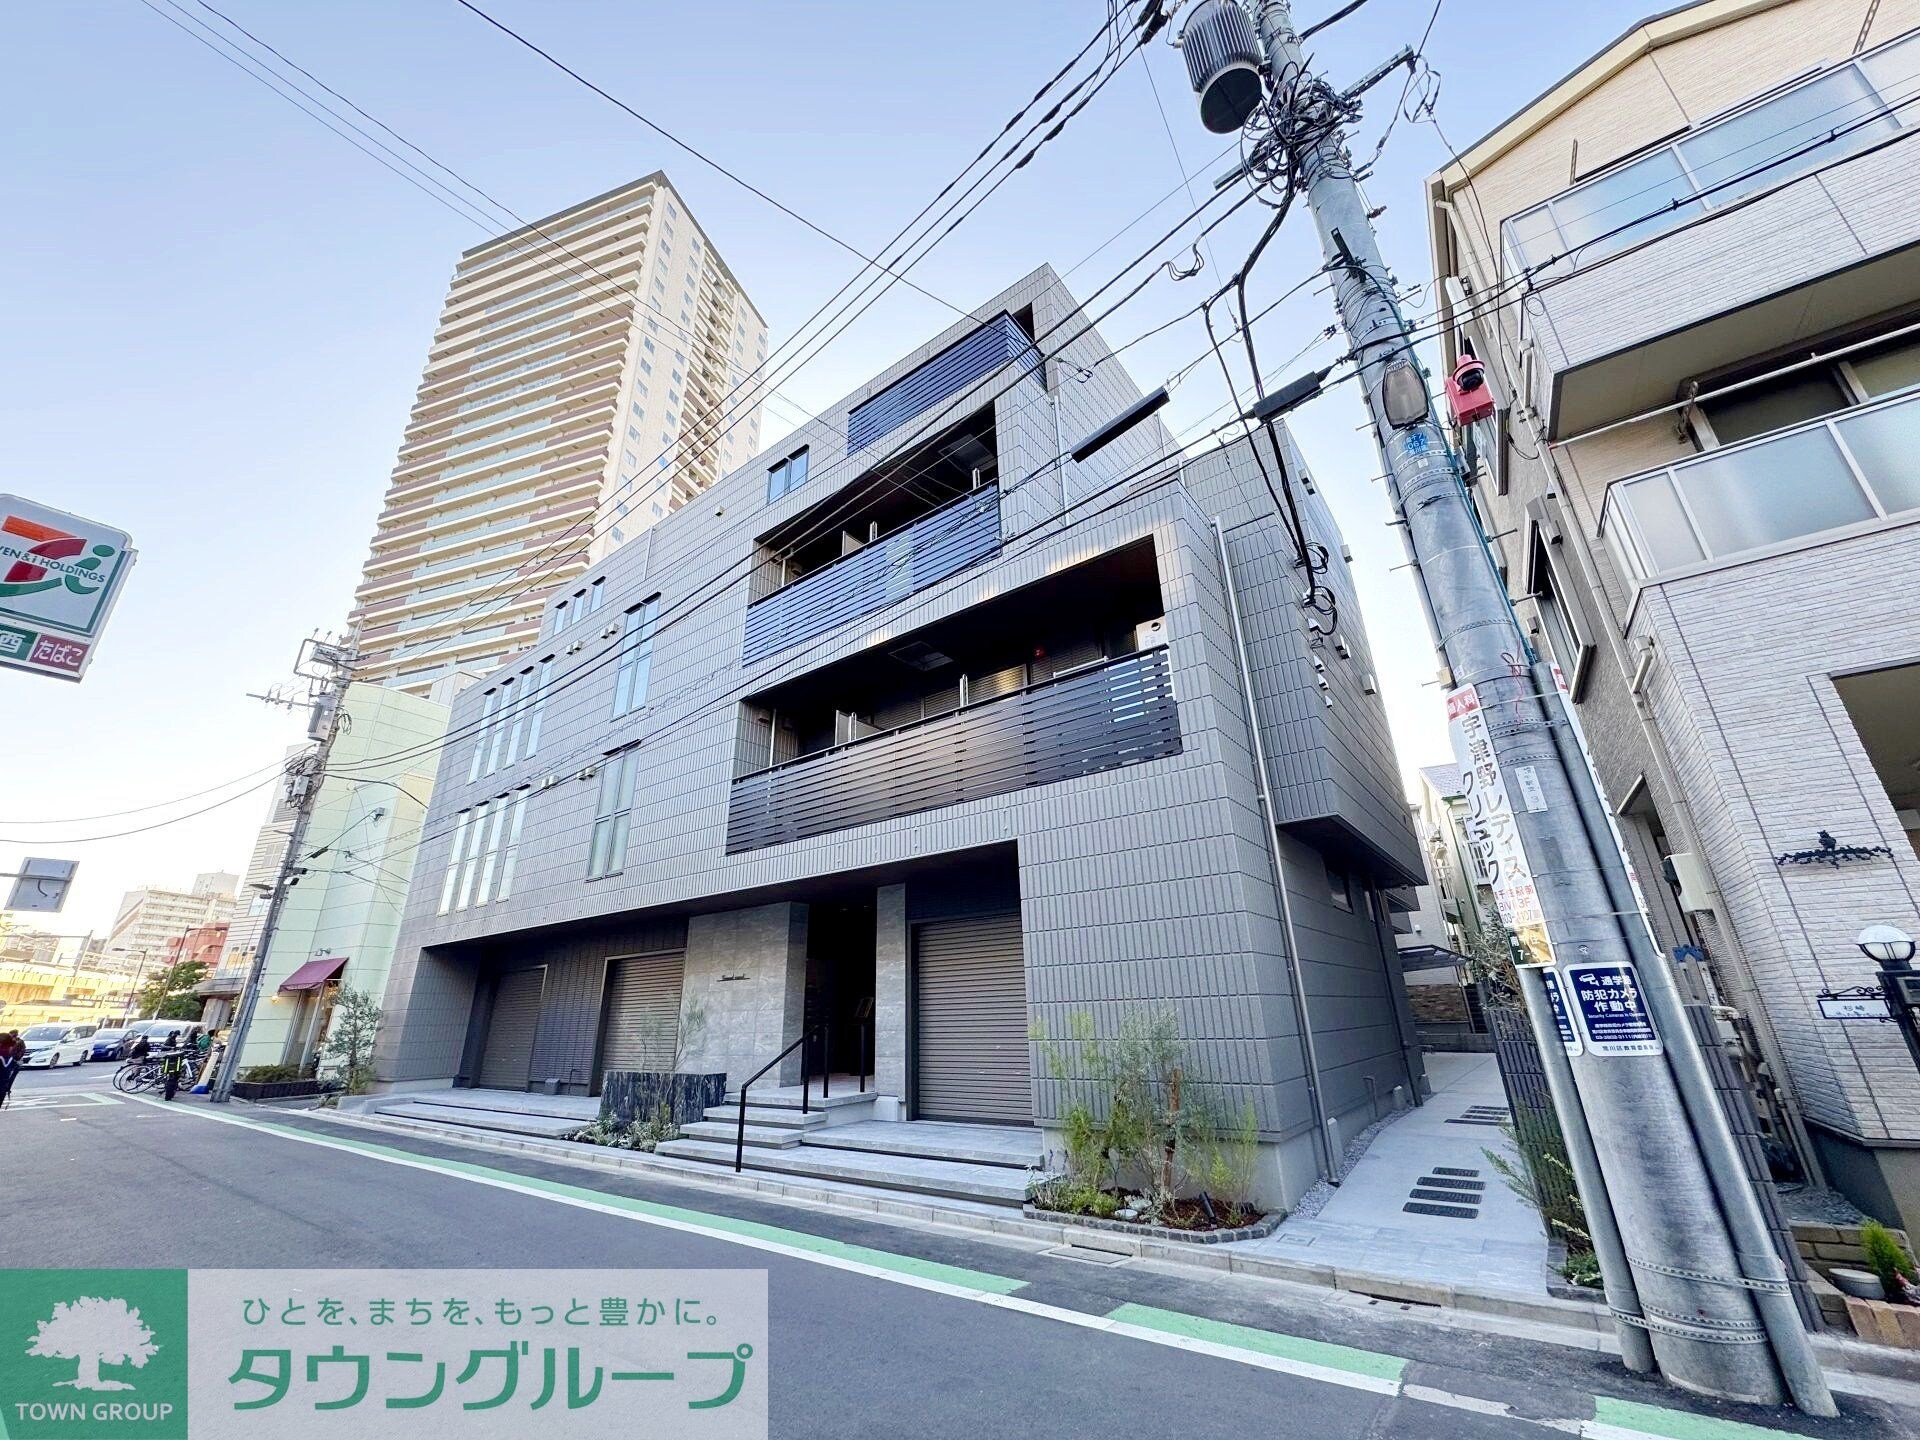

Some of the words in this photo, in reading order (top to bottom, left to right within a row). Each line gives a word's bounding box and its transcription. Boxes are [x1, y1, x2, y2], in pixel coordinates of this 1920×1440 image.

[39, 558, 105, 583] HOLDINGS
[34, 640, 83, 666] たばこ
[1463, 770, 1499, 885] クリニック
[1601, 975, 1632, 986] 通学路
[1581, 988, 1637, 1001] 防犯カメラ
[1594, 1000, 1637, 1013] 作動中
